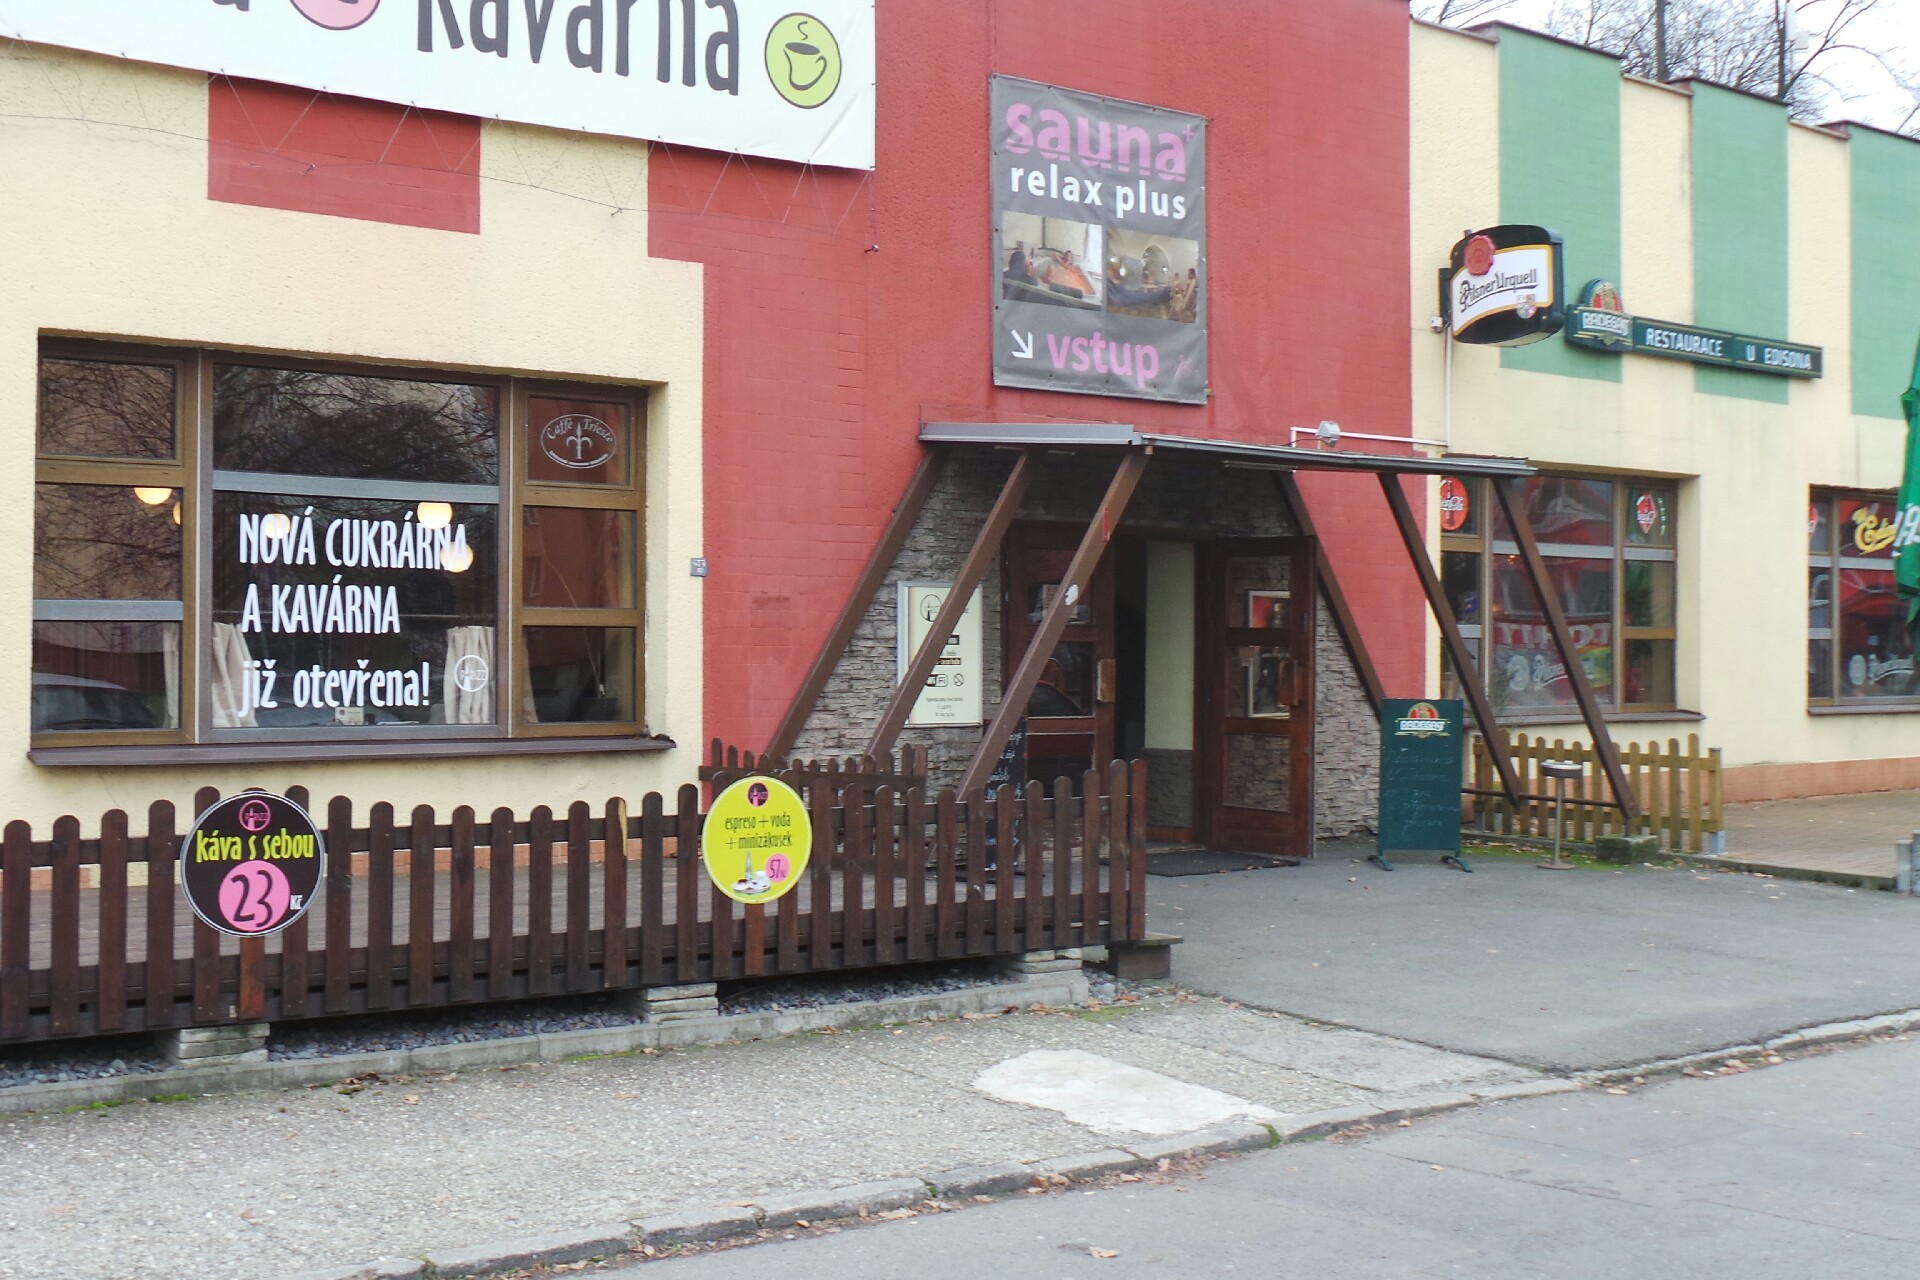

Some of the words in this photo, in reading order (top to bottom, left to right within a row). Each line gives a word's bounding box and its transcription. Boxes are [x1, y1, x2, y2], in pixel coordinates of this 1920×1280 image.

[1011, 164, 1102, 206] relax
[1116, 180, 1187, 220] plus
[1460, 280, 1496, 313] Pilsner
[1495, 269, 1537, 293] Urquell
[1047, 331, 1159, 388] vstup
[1645, 328, 1723, 357] RESTAURACE
[1745, 344, 1756, 362] U
[1763, 347, 1812, 370] EDISONA
[583, 418, 614, 443] Trieste
[239, 505, 316, 565] NOVÁ
[325, 510, 469, 571] CUKRÁRNA
[241, 583, 262, 633] A
[271, 574, 400, 634] KAVÁRNA
[238, 658, 278, 718] již
[292, 658, 430, 708] otevřena!
[770, 811, 791, 828] voda
[196, 829, 242, 863] káva
[248, 834, 257, 860] s
[262, 827, 314, 860] sebou
[769, 859, 781, 879] 57
[230, 869, 273, 928] 23
